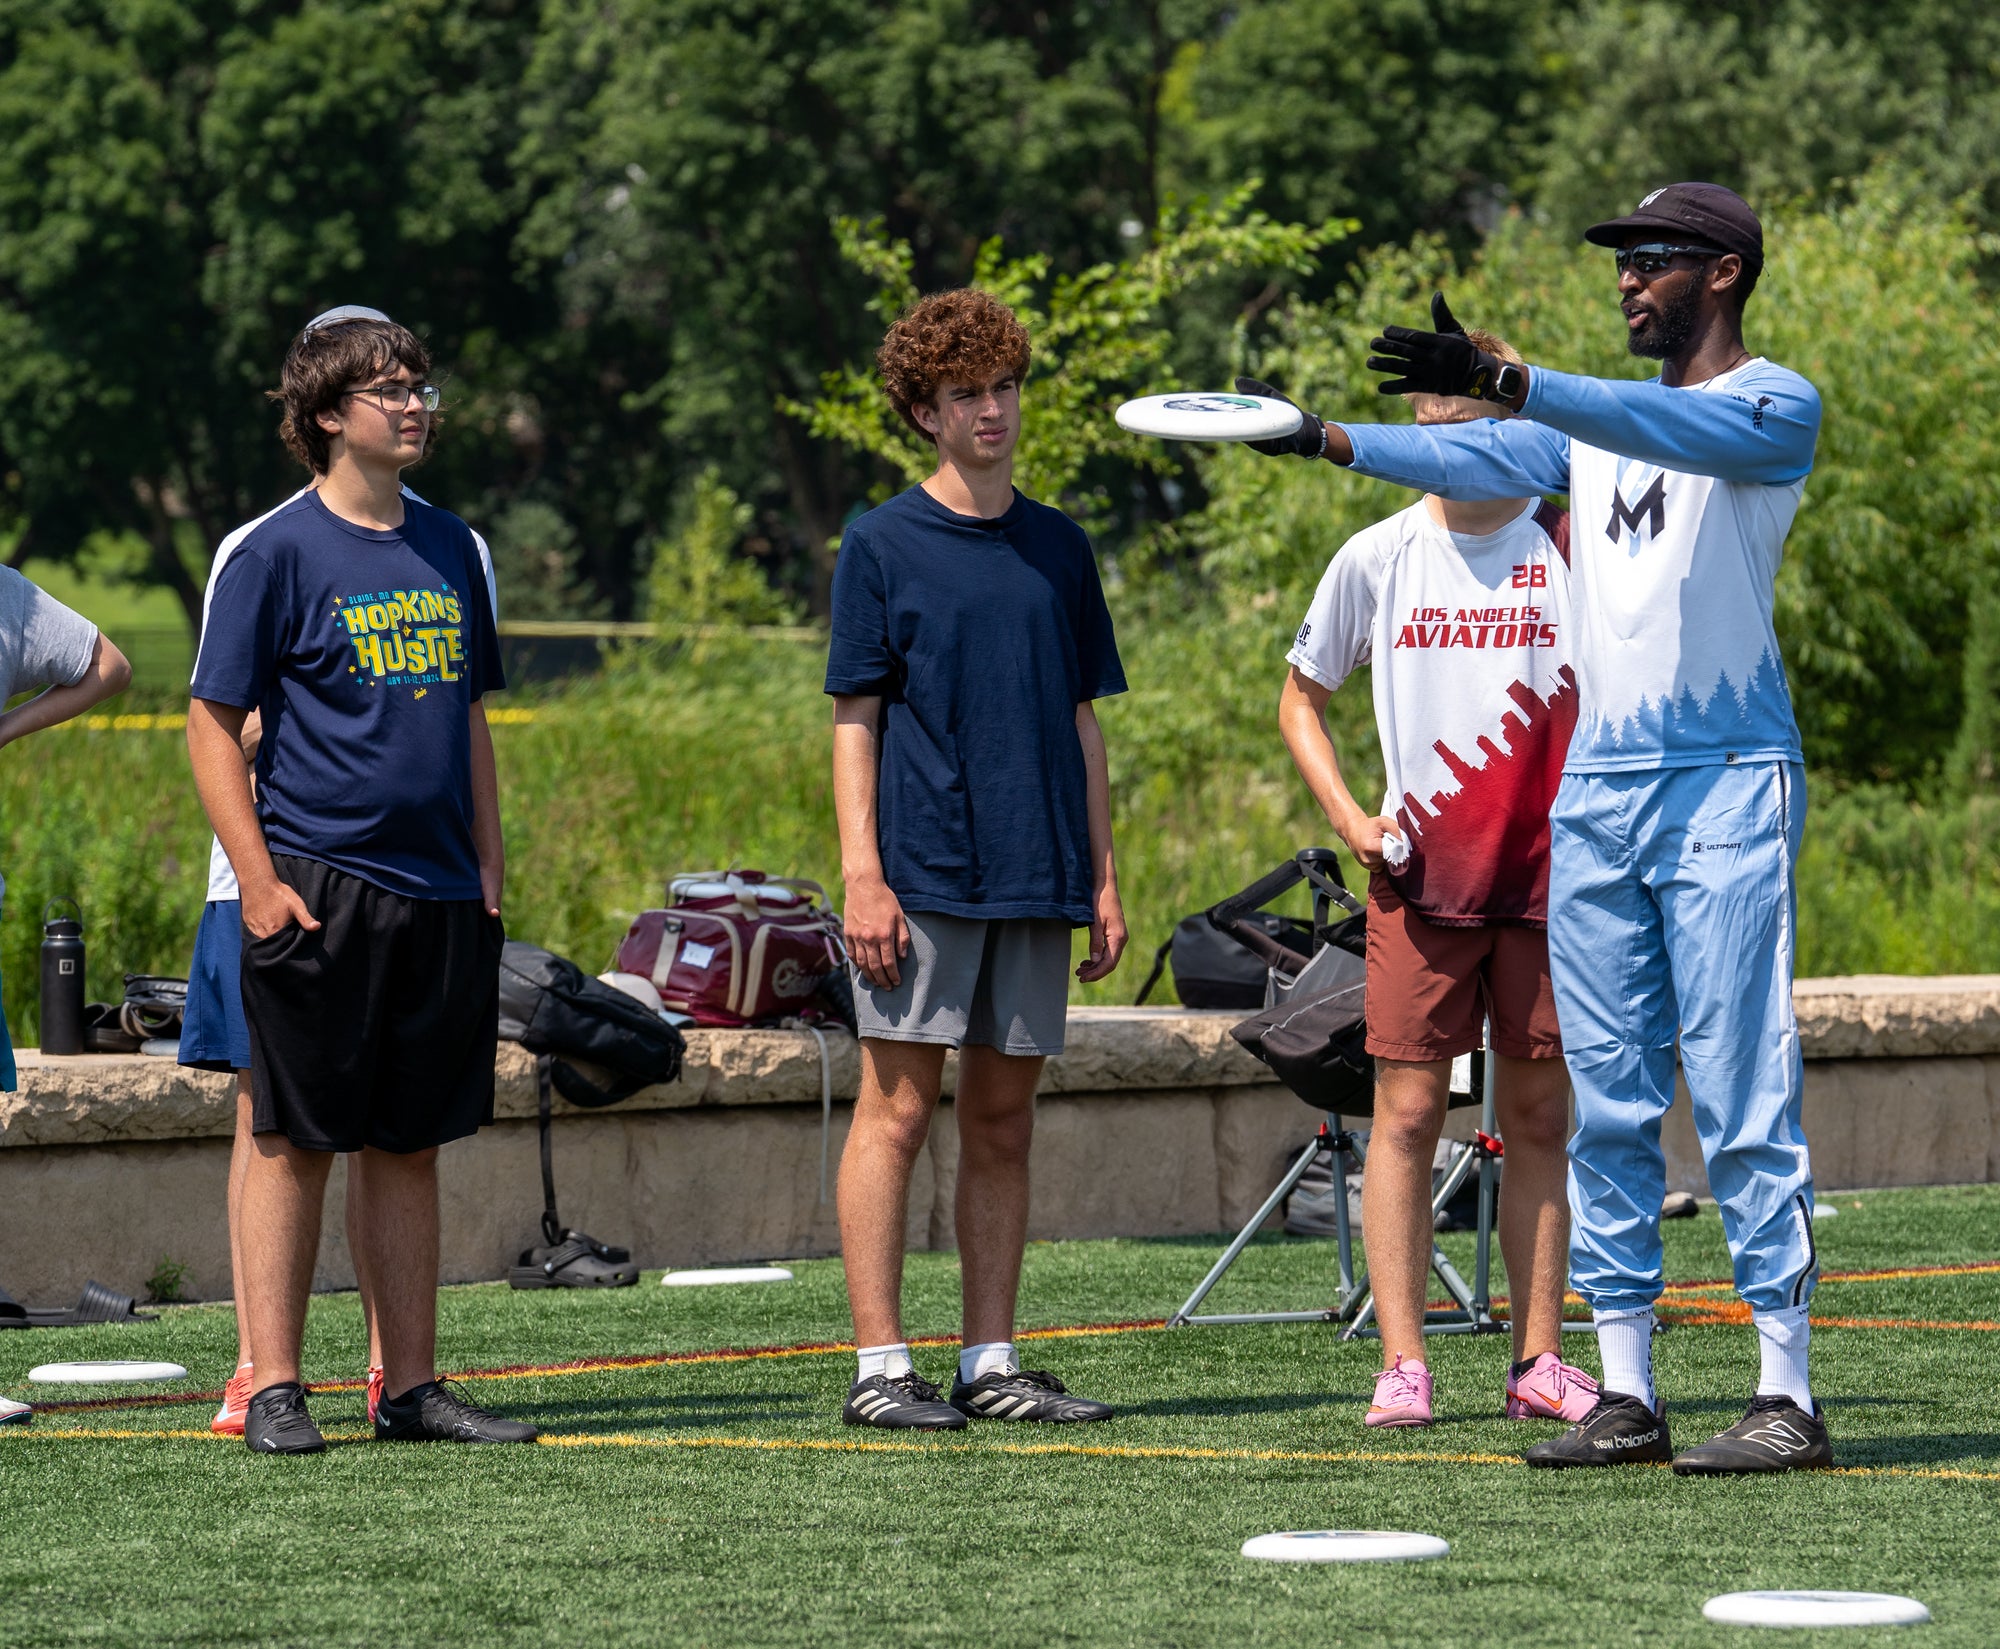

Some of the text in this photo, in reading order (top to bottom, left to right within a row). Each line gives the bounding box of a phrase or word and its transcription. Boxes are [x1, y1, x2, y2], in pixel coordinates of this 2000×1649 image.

[1511, 564, 1547, 589] 28
[340, 590, 461, 634] HOPKINS
[1411, 606, 1542, 623] LOS ANGELES
[1394, 622, 1559, 649] AVIATORS
[352, 628, 464, 681] HUSTLE
[1706, 842, 1742, 851] ULTIMATE
[1592, 1428, 1660, 1450] new balance
